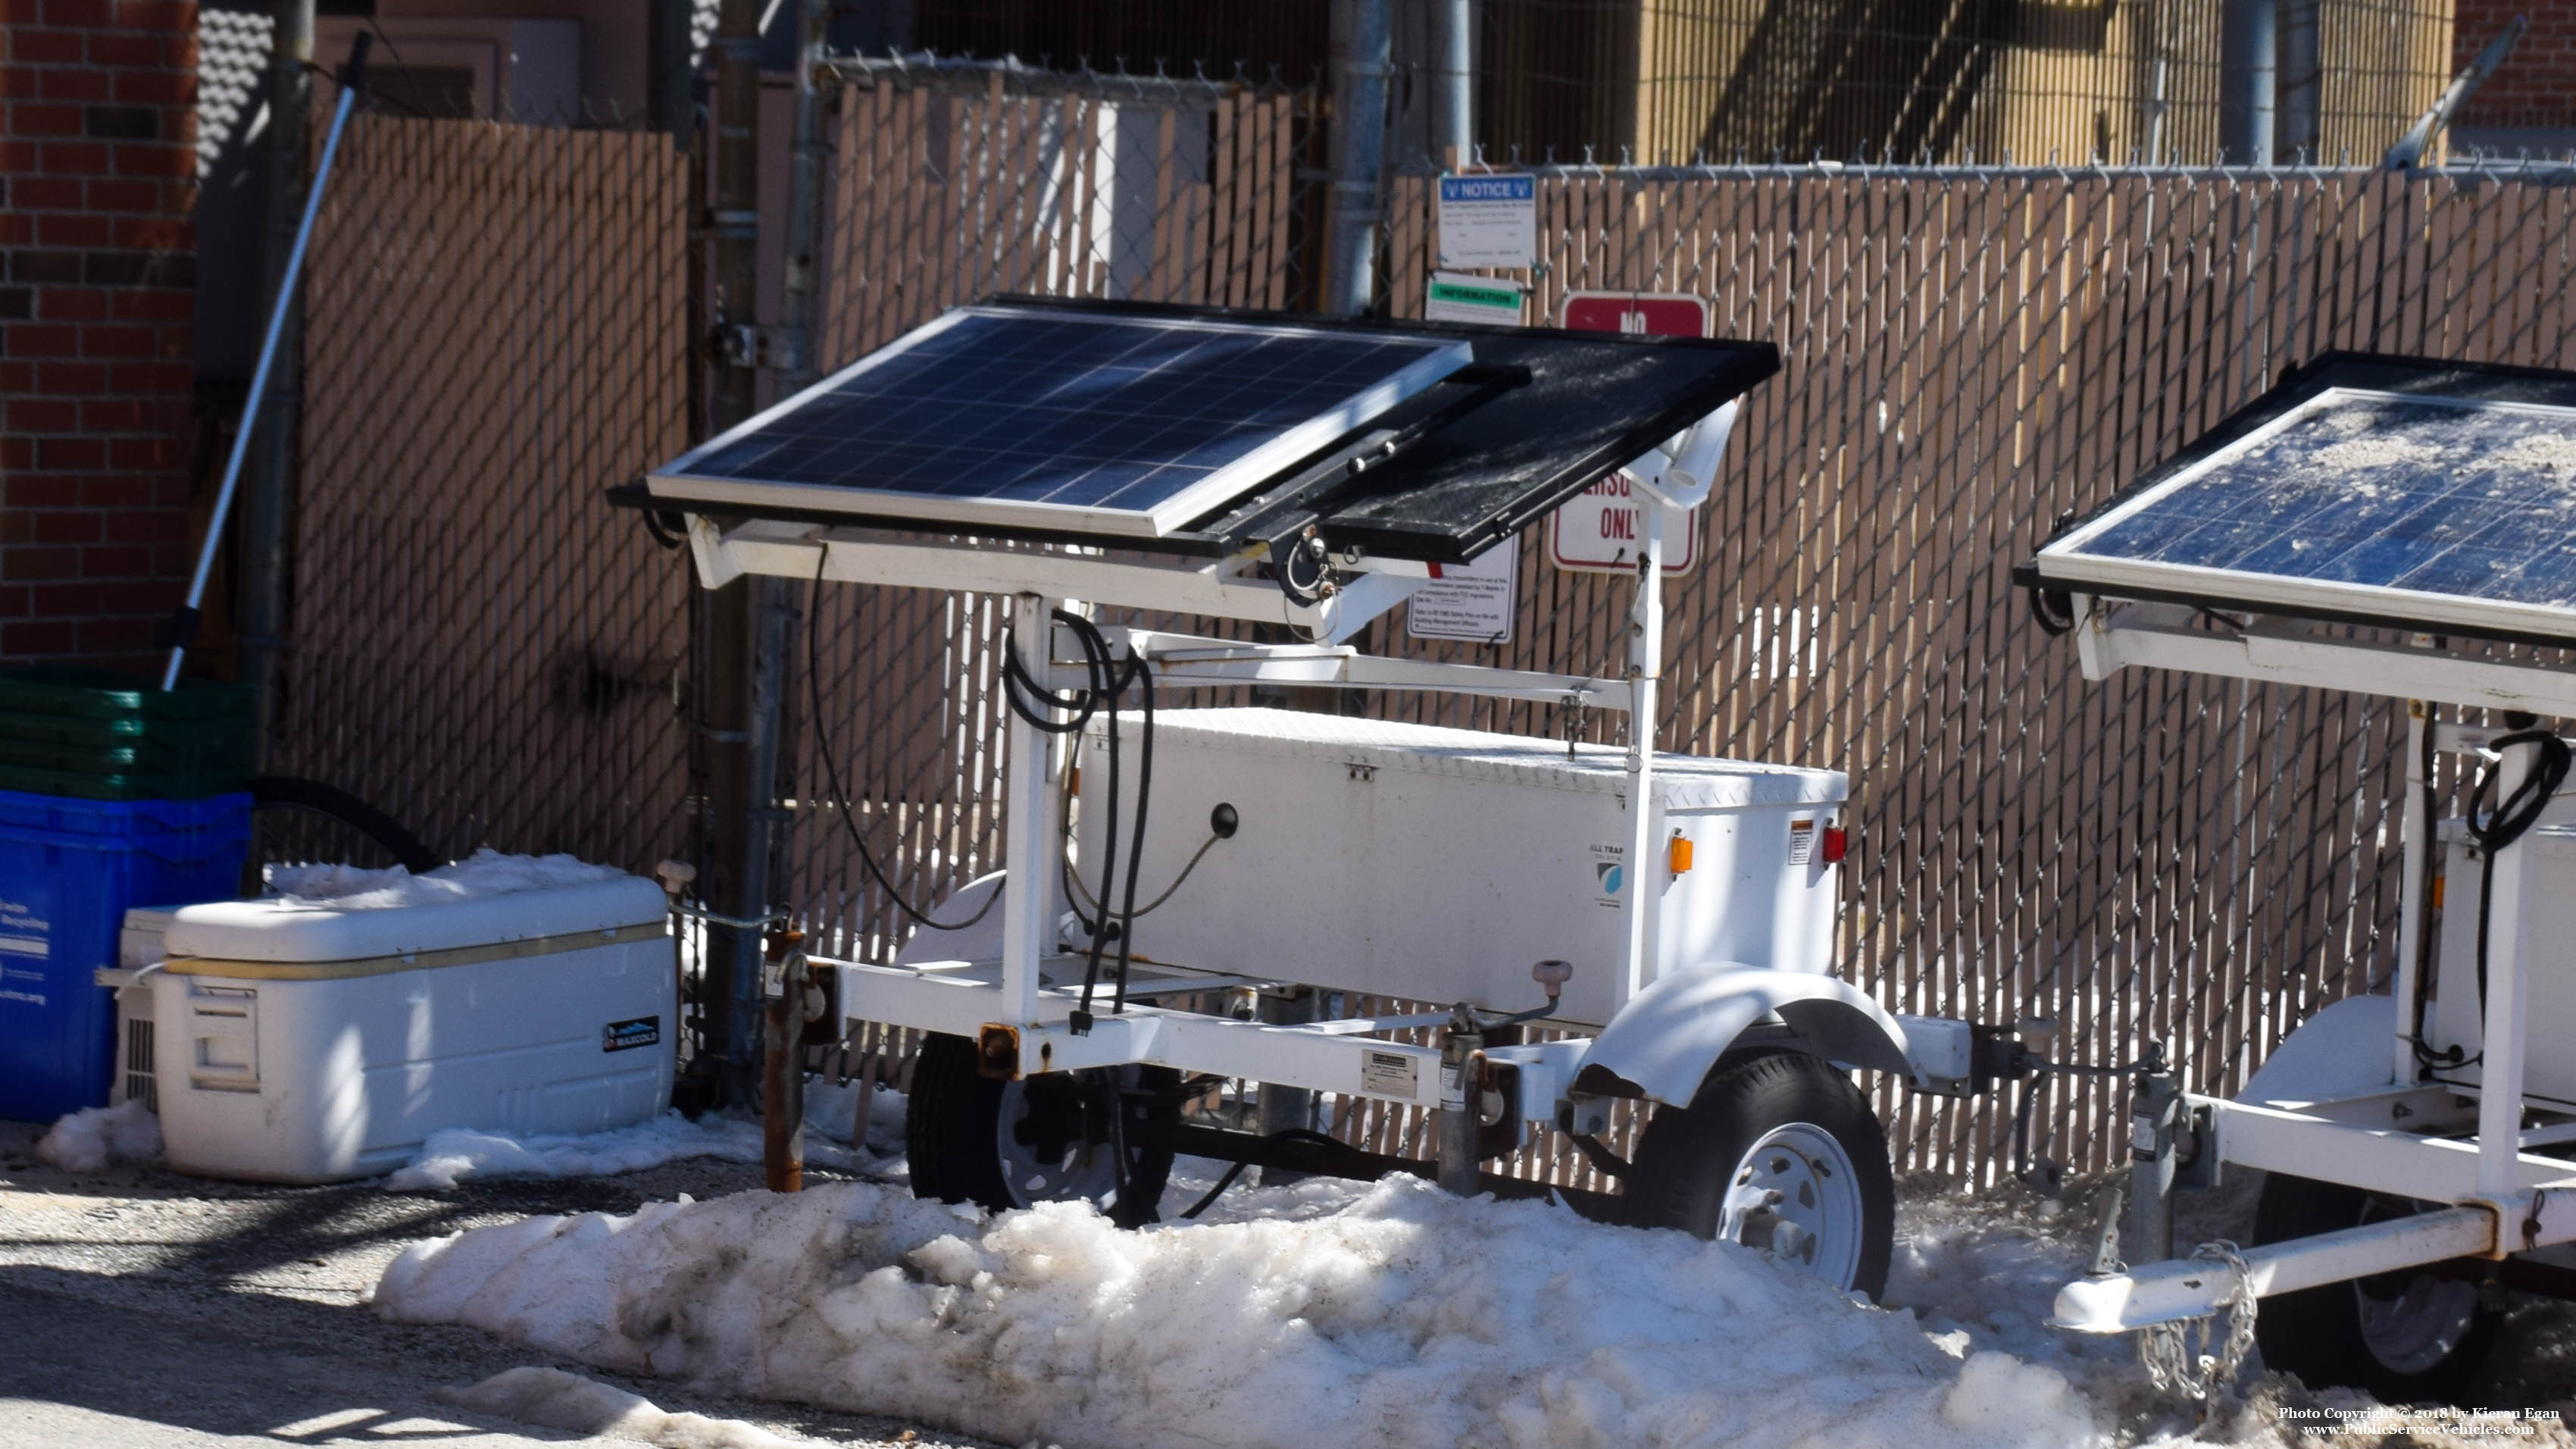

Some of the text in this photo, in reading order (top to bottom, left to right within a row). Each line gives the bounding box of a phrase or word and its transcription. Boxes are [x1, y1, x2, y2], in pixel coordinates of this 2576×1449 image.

[1461, 182, 1512, 197] NOTICE
[1440, 285, 1512, 303] INFORMATION
[1620, 311, 1646, 334] NO
